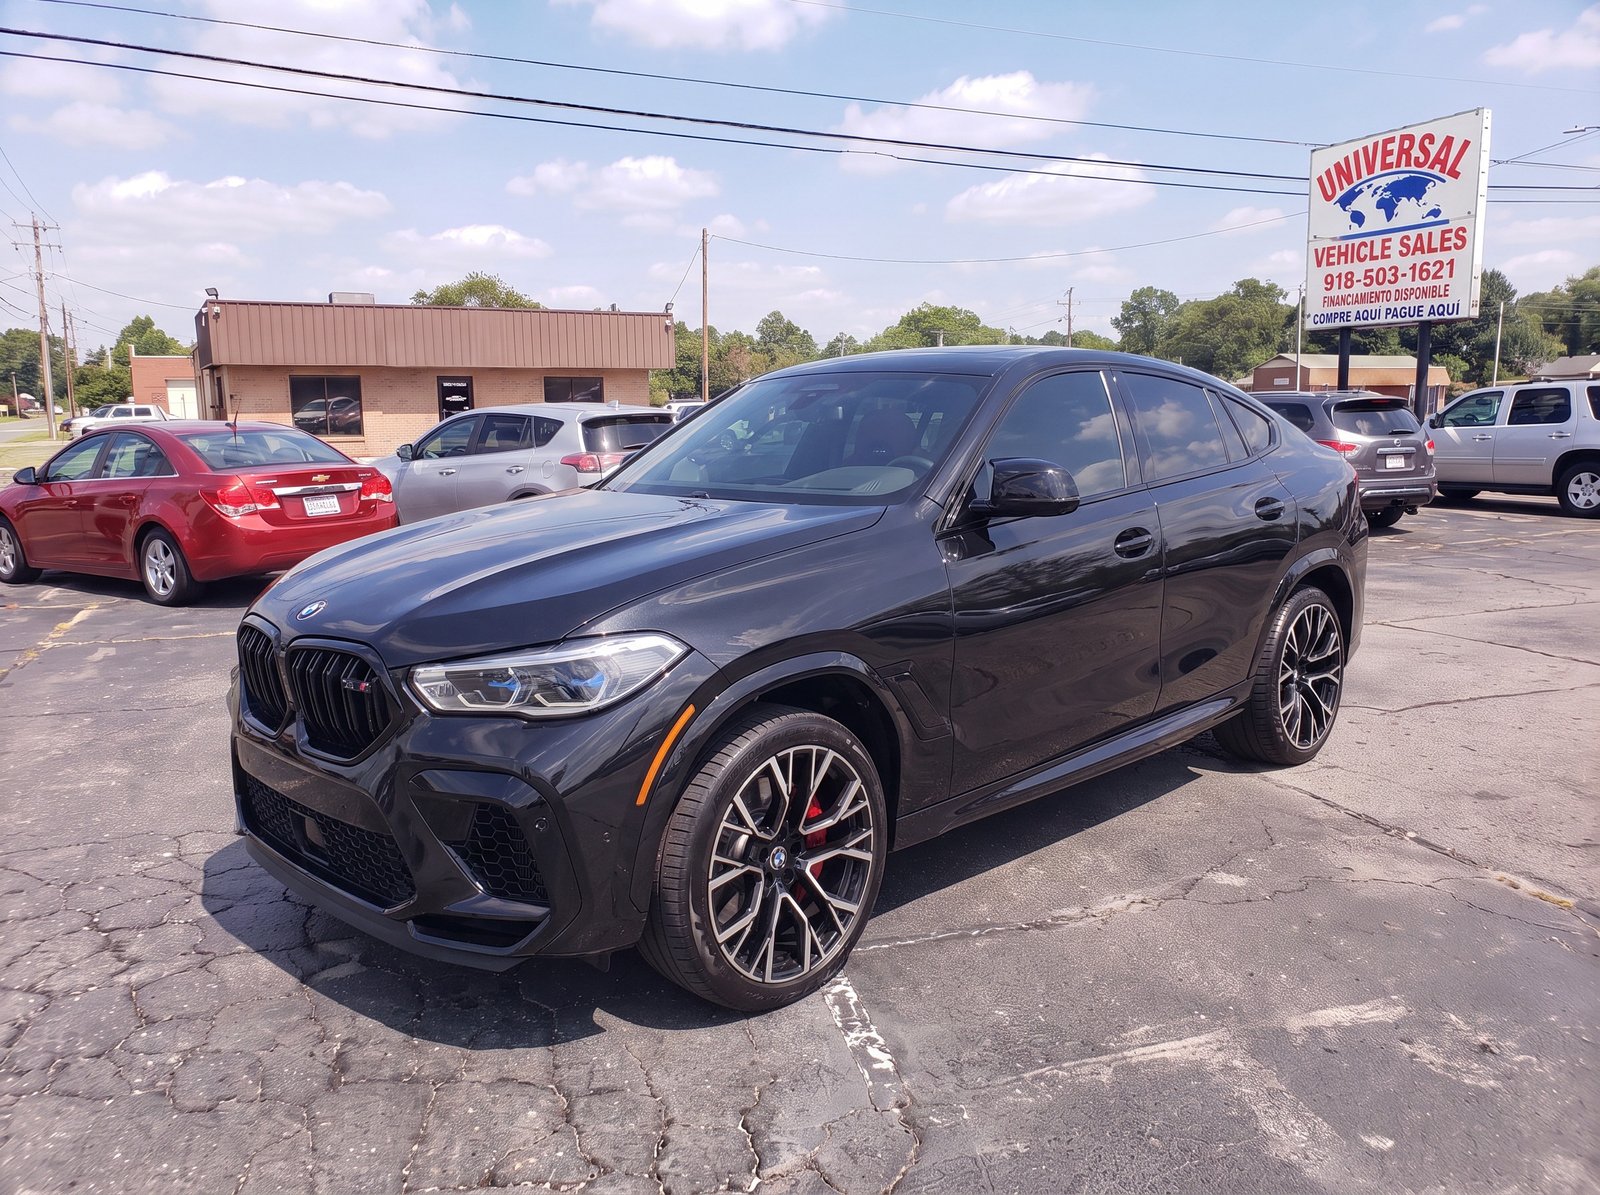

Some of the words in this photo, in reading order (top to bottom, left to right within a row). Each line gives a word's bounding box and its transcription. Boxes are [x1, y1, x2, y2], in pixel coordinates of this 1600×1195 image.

[1316, 132, 1472, 203] UNIVERSAL
[1314, 237, 1392, 268] VEHICLE
[1398, 226, 1468, 258] SALES
[1323, 258, 1456, 292] 918-503-1621
[1322, 289, 1392, 308] FINANCIAMIENTO
[1394, 283, 1450, 302] DISPONIBLE
[1312, 310, 1352, 325] COMPRE
[1384, 304, 1425, 320] PAGUE
